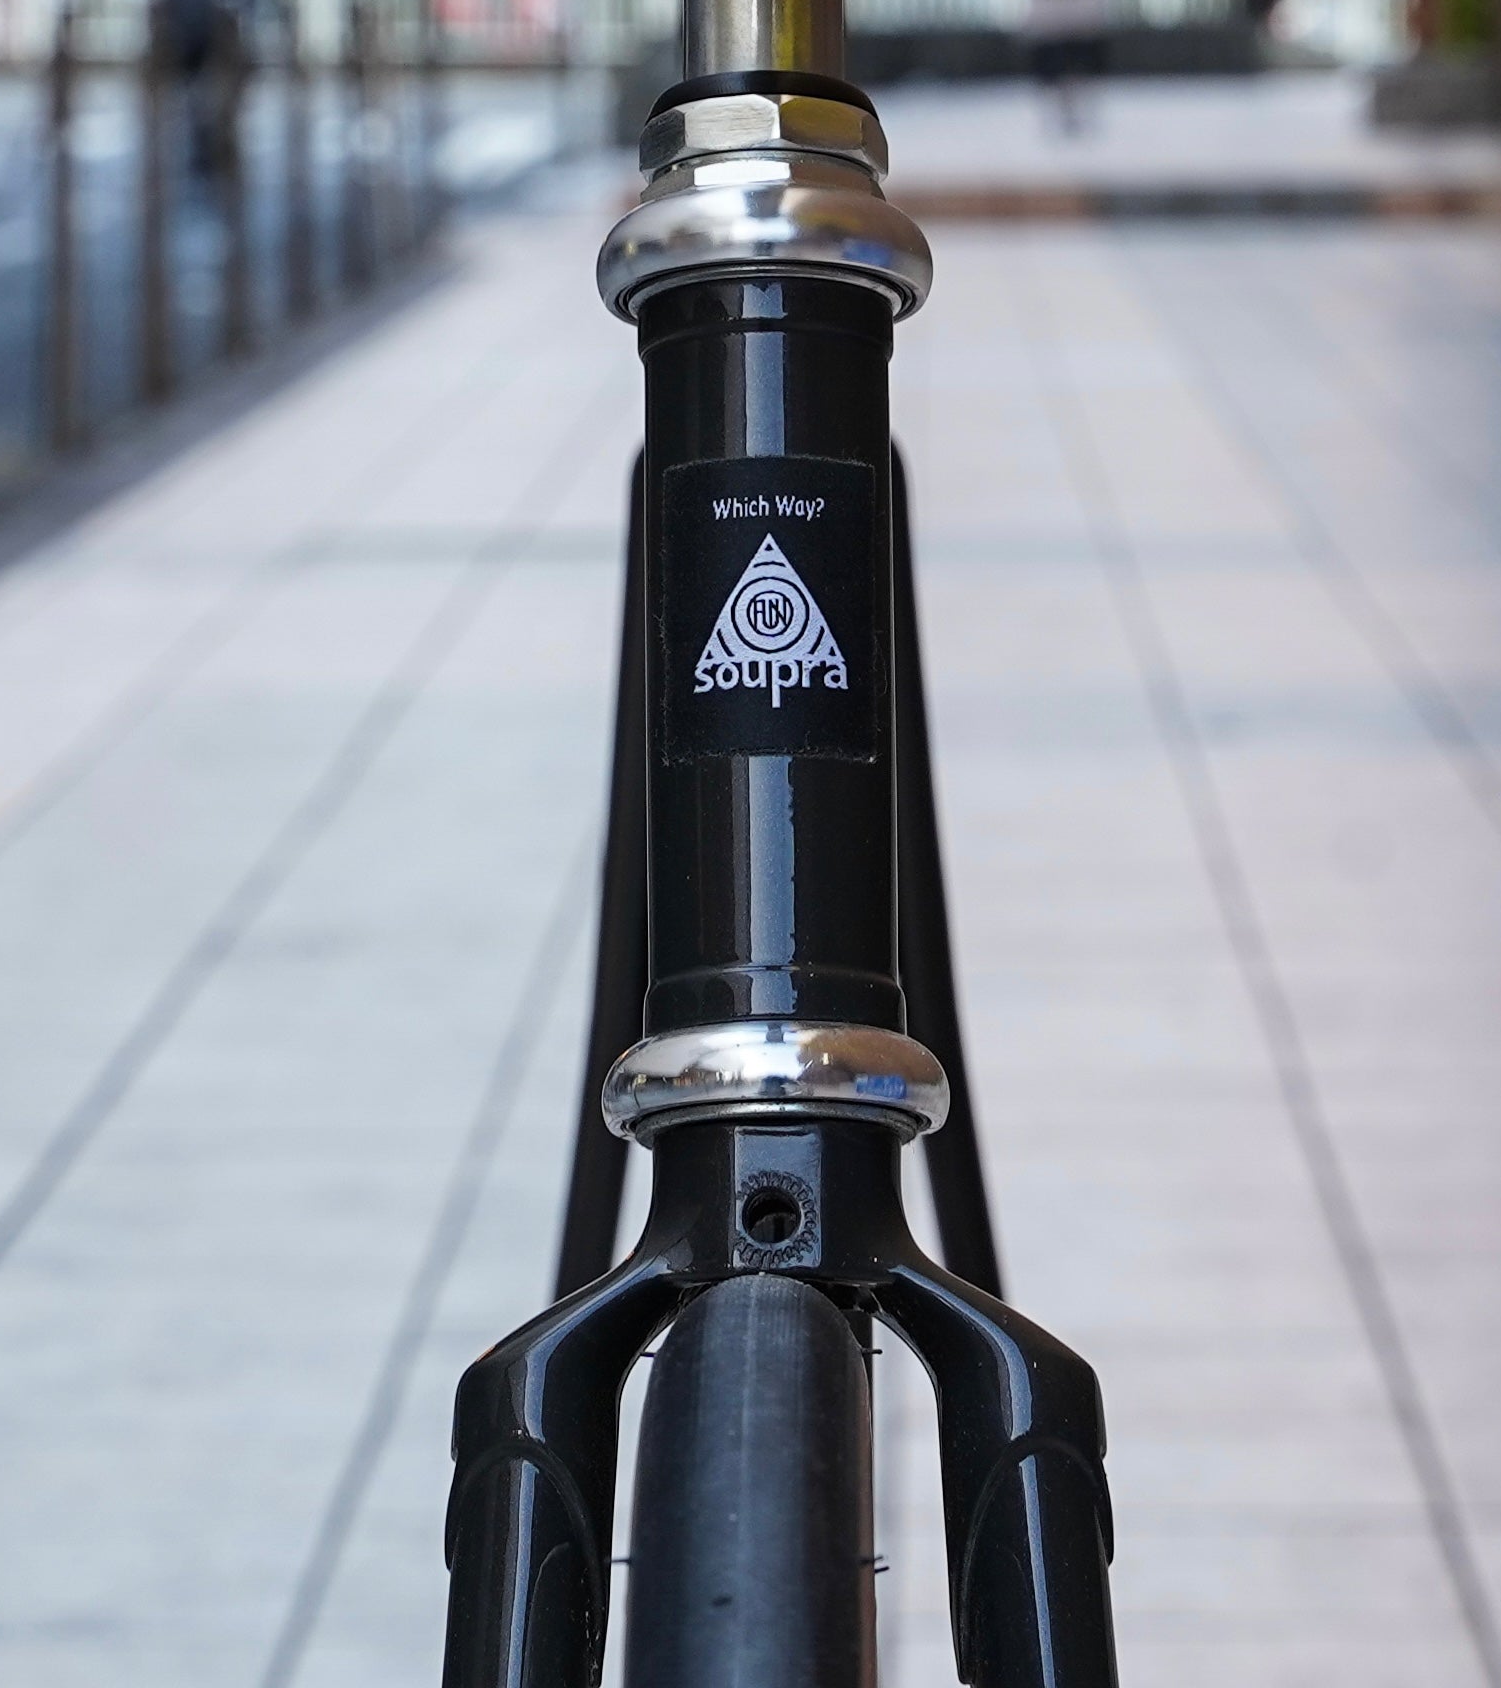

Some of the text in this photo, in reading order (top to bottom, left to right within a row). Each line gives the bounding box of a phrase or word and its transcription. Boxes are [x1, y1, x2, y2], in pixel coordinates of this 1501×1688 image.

[712, 494, 825, 521] Which Way?
[693, 660, 849, 708] soupra
